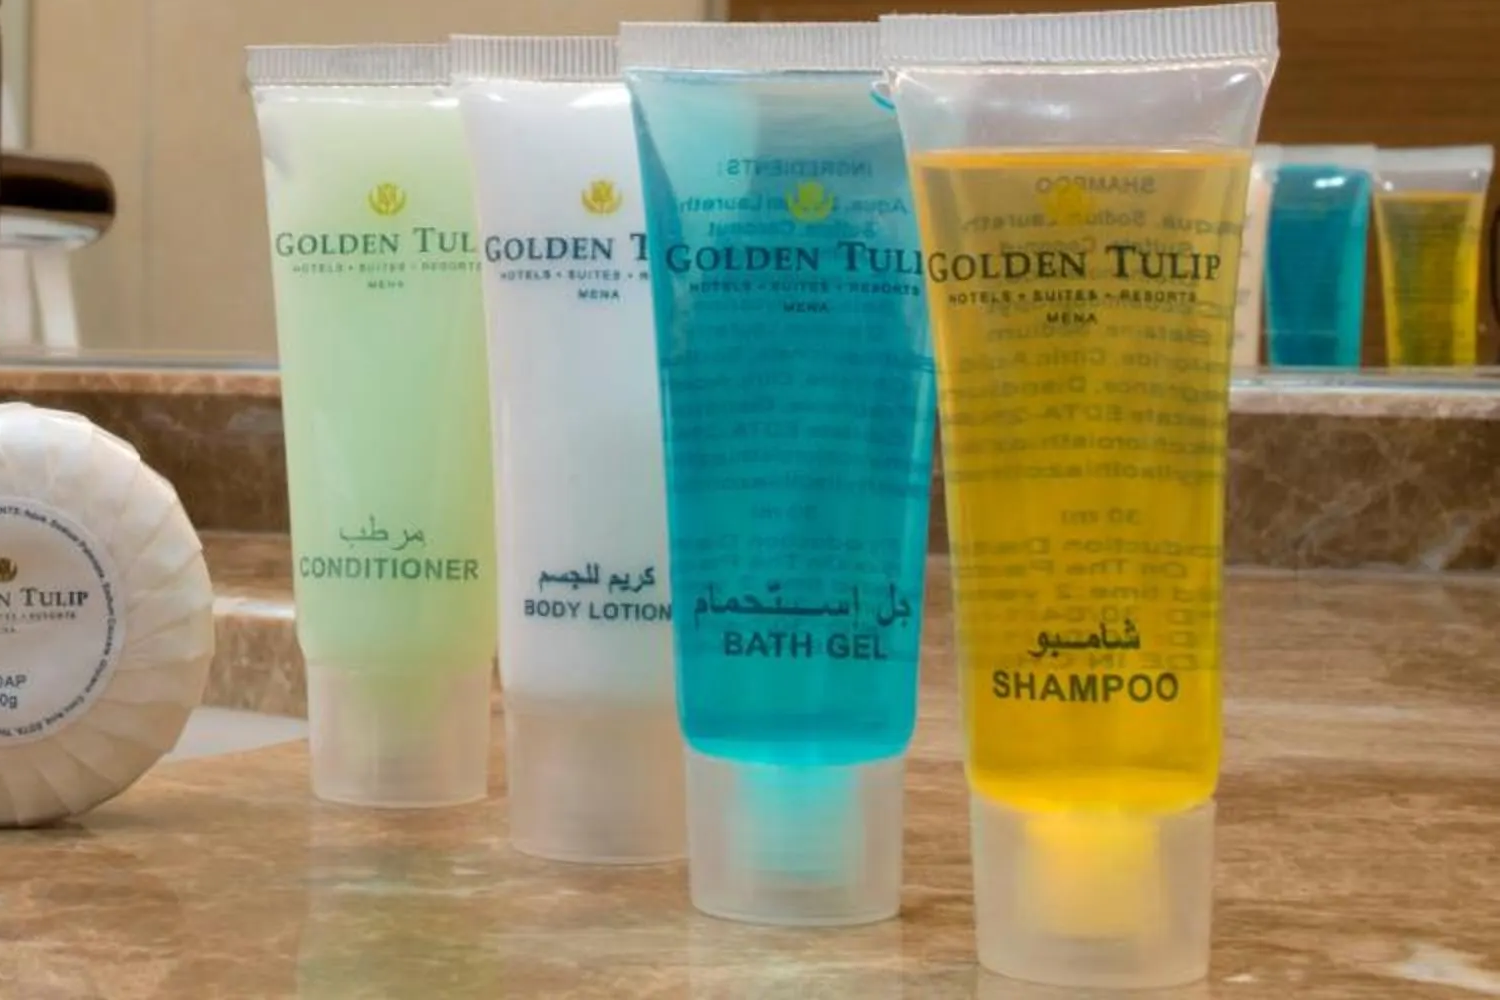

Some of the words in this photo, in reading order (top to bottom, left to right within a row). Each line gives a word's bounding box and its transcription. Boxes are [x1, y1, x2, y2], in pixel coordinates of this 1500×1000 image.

[275, 232, 401, 257] GOLDEN
[412, 226, 478, 253] TUL
[485, 236, 614, 262] GOLDEN
[359, 261, 406, 272] SUITES
[665, 244, 820, 273] GOLDEN
[837, 240, 923, 275] TULI
[927, 251, 1087, 283] GOLDEN
[1105, 244, 1221, 280] TULIP
[501, 269, 551, 281] HOTELS
[567, 270, 621, 281] SUITES
[577, 287, 620, 300] MENA
[689, 281, 751, 294] HOTELS
[767, 280, 828, 294] SUITES
[850, 282, 921, 297] RESORTS
[948, 289, 1012, 305] HOTELS
[1033, 289, 1098, 303] SUITES
[1119, 289, 1198, 304] RESORTS
[782, 302, 831, 315] MENA
[1046, 312, 1098, 325] MENA
[299, 556, 480, 581] CONDITIONER
[19, 586, 89, 608] TULIP
[523, 599, 581, 618] BODY
[588, 602, 673, 621] LOTION
[723, 630, 813, 659] BATH
[826, 632, 889, 660] GEL
[991, 669, 1180, 703] SHAMPOO
